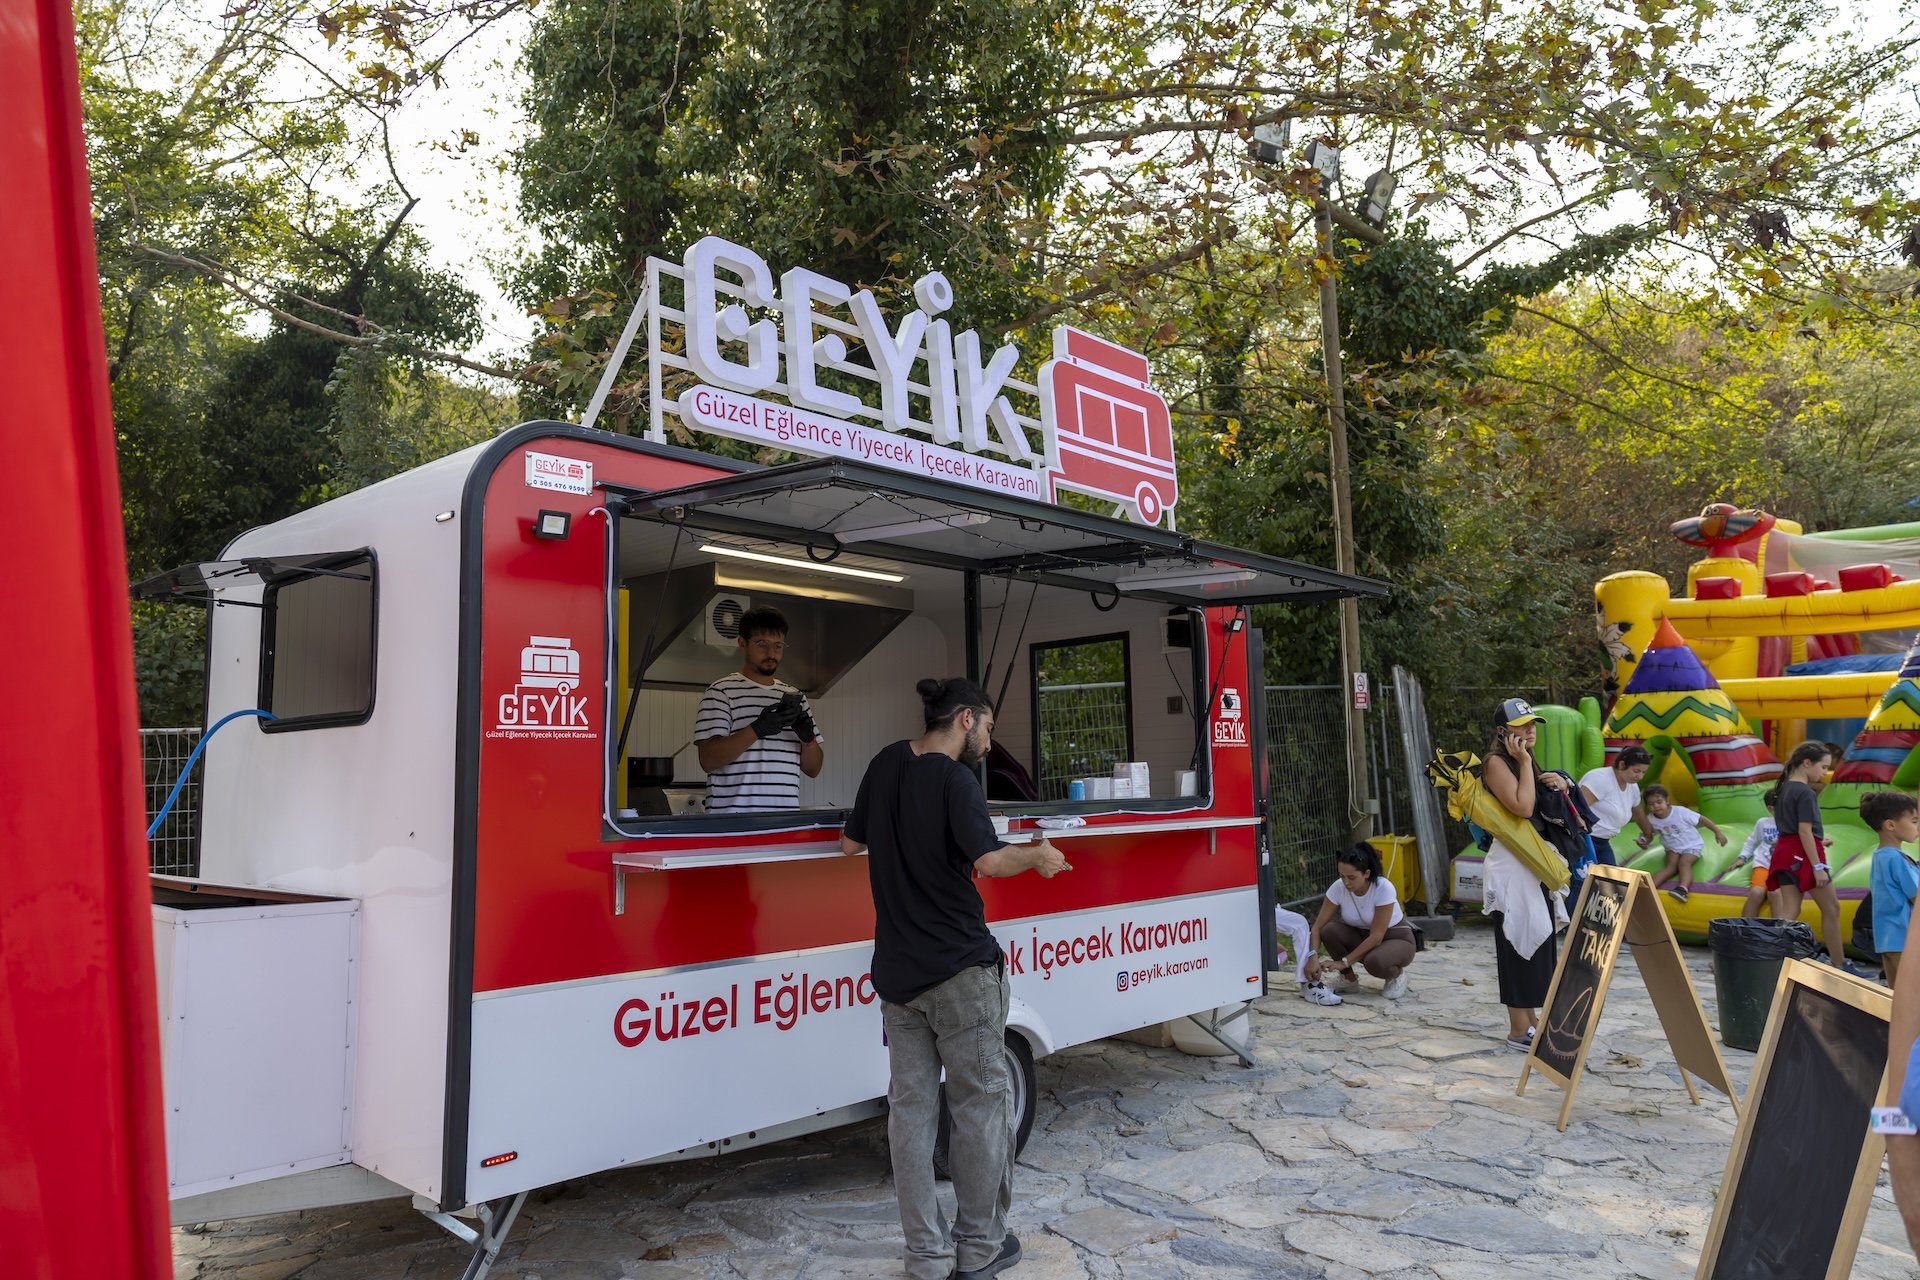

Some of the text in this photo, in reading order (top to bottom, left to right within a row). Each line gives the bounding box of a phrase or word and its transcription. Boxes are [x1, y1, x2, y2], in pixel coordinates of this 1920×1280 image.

[683, 235, 1032, 462] GEYİK
[696, 391, 1039, 495] Güzel Eğlence Yiyecek İçecek Karavanı
[535, 459, 566, 474] GEYİK
[499, 682, 589, 726] GEYİK
[505, 731, 529, 740] Eğlence
[530, 731, 552, 740] Yiyecek
[1214, 717, 1246, 740] GEYİK
[613, 983, 738, 1048] Güzel
[754, 972, 877, 1031] Eğlenc
[1032, 926, 1114, 980] İçecek
[1120, 917, 1208, 955] Karavanı
[1131, 956, 1209, 987] geyik.karavan
